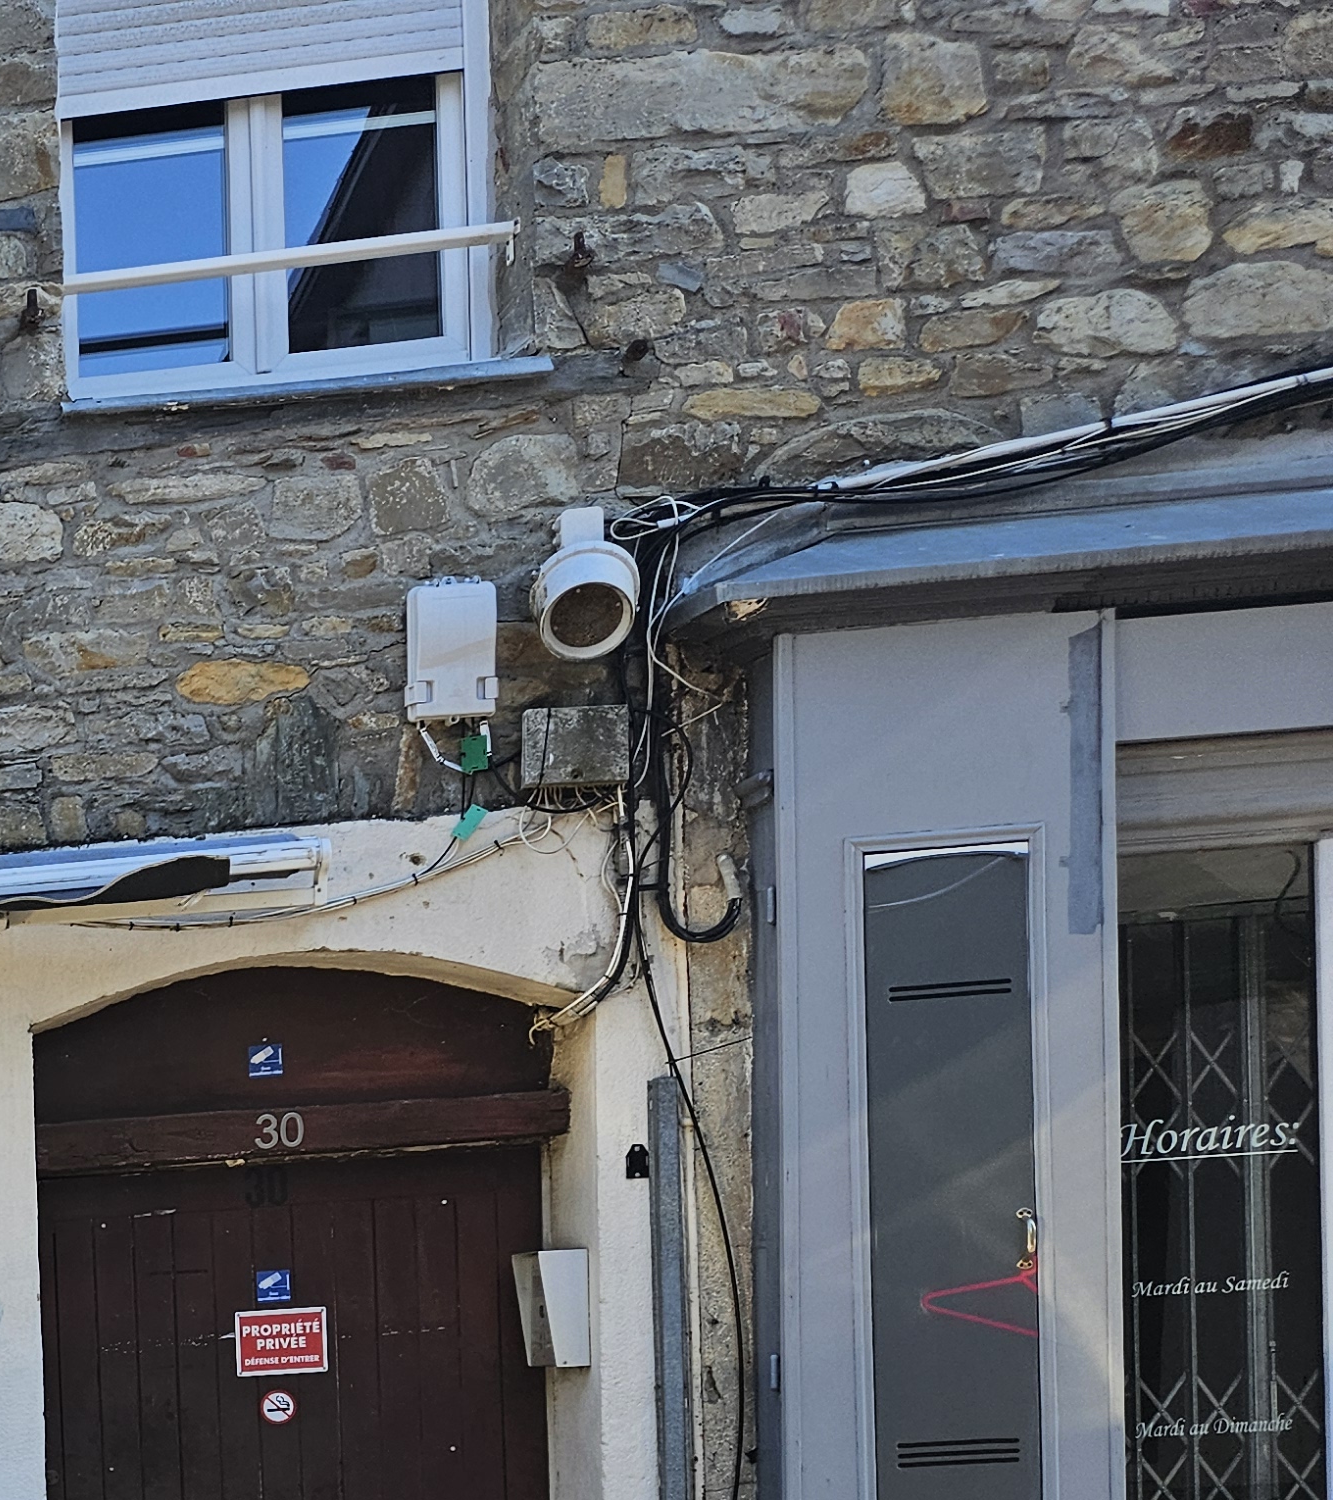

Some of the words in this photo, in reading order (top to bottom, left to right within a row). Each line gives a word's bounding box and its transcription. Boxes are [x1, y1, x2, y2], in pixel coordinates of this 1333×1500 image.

[254, 1111, 304, 1149] 30
[1120, 1114, 1300, 1158] Horaires:
[1131, 1276, 1191, 1298] Mardi
[1194, 1280, 1218, 1294] au
[1221, 1270, 1290, 1294] Samedi
[242, 1317, 321, 1338] PROPRIÉTÉ
[256, 1334, 307, 1351] PRIVÉE
[244, 1356, 279, 1366] DÉFENSE
[281, 1354, 320, 1364] D'ENTRER
[1135, 1418, 1186, 1439] Mardi
[1189, 1423, 1210, 1436] au
[1213, 1412, 1293, 1434] Dimanche
